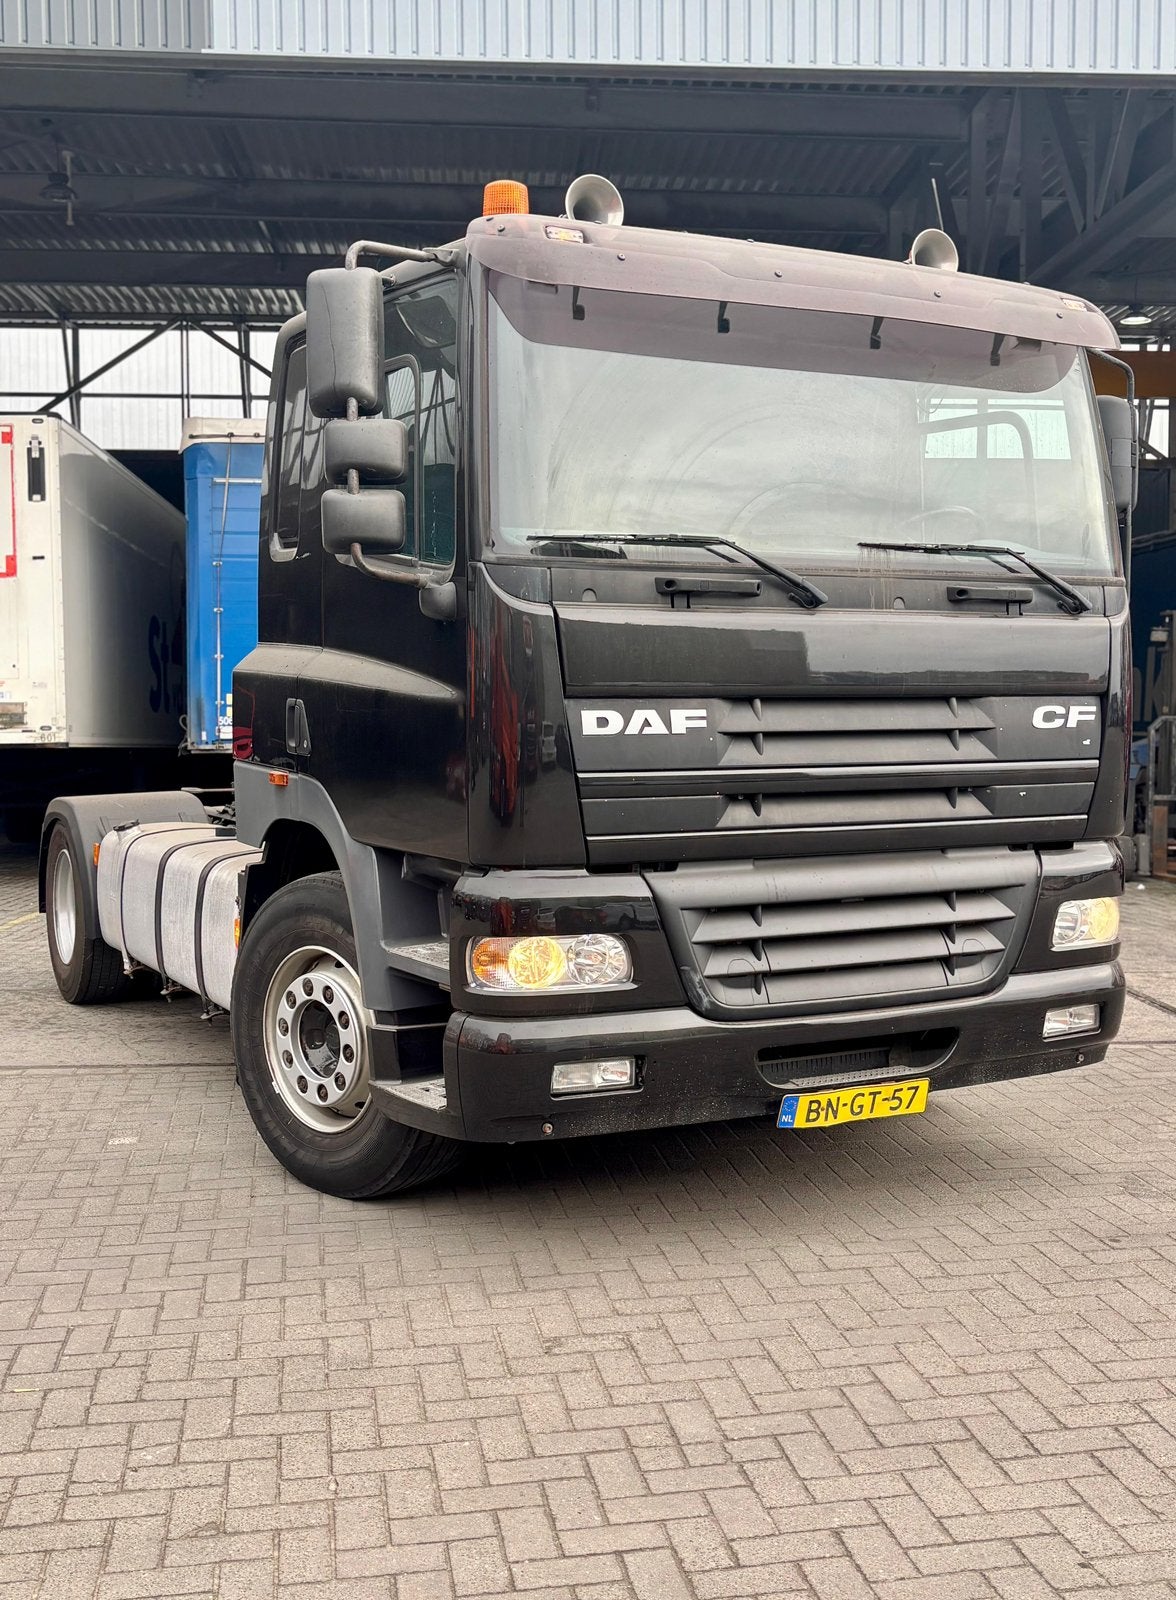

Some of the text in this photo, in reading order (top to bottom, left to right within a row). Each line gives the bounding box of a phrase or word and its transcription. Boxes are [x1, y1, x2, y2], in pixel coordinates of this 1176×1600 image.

[580, 709, 707, 736] DAF
[1032, 705, 1097, 729] CF
[805, 1085, 920, 1124] BN-GT-57
[781, 1114, 793, 1123] NL
